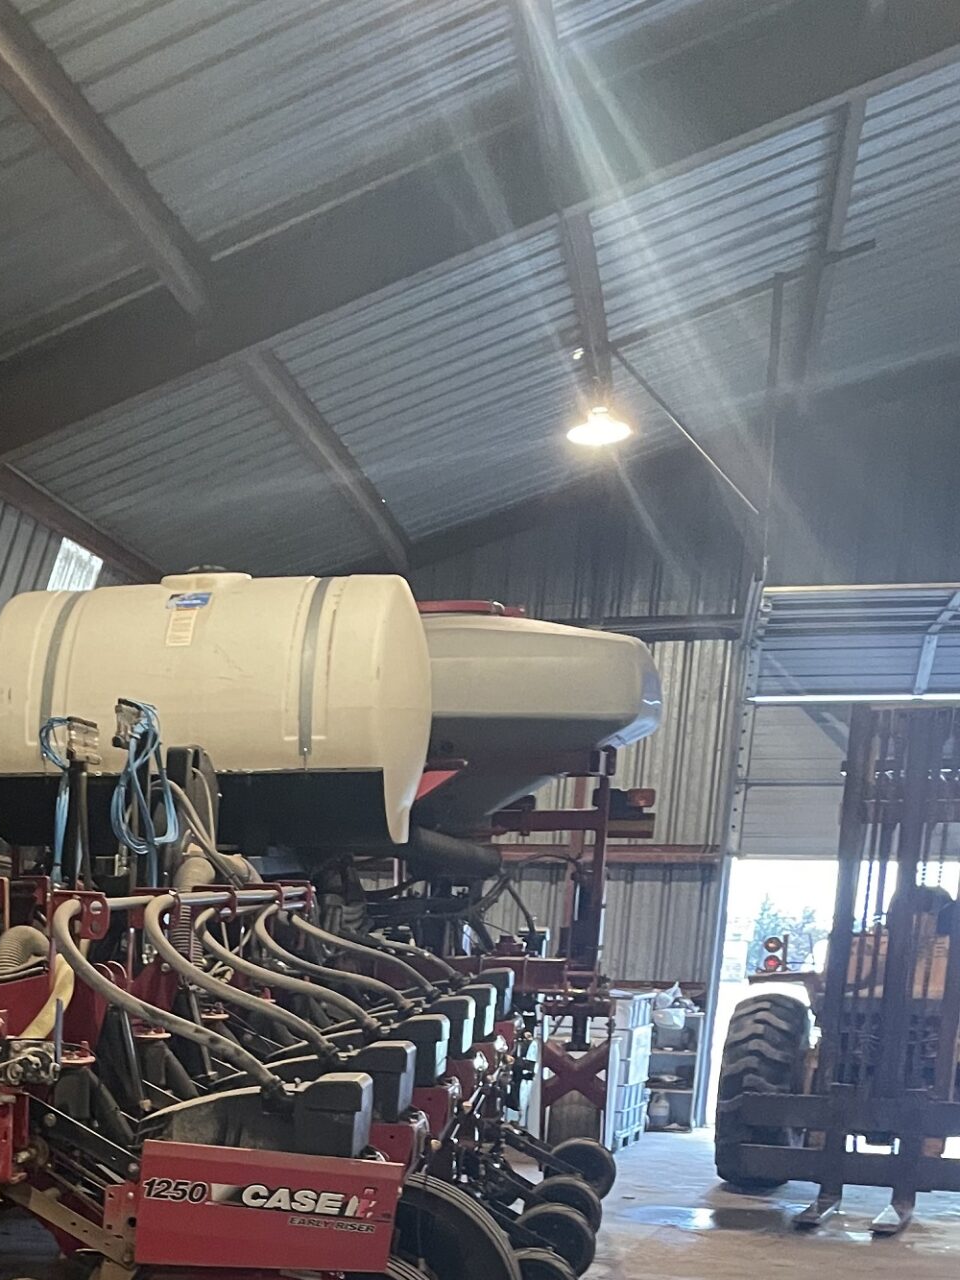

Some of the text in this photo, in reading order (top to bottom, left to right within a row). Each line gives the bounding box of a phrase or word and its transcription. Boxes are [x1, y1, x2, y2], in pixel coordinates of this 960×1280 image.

[143, 1177, 208, 1204] 1250
[241, 1184, 345, 1216] CASE
[289, 1217, 375, 1233] EARLY RISER
